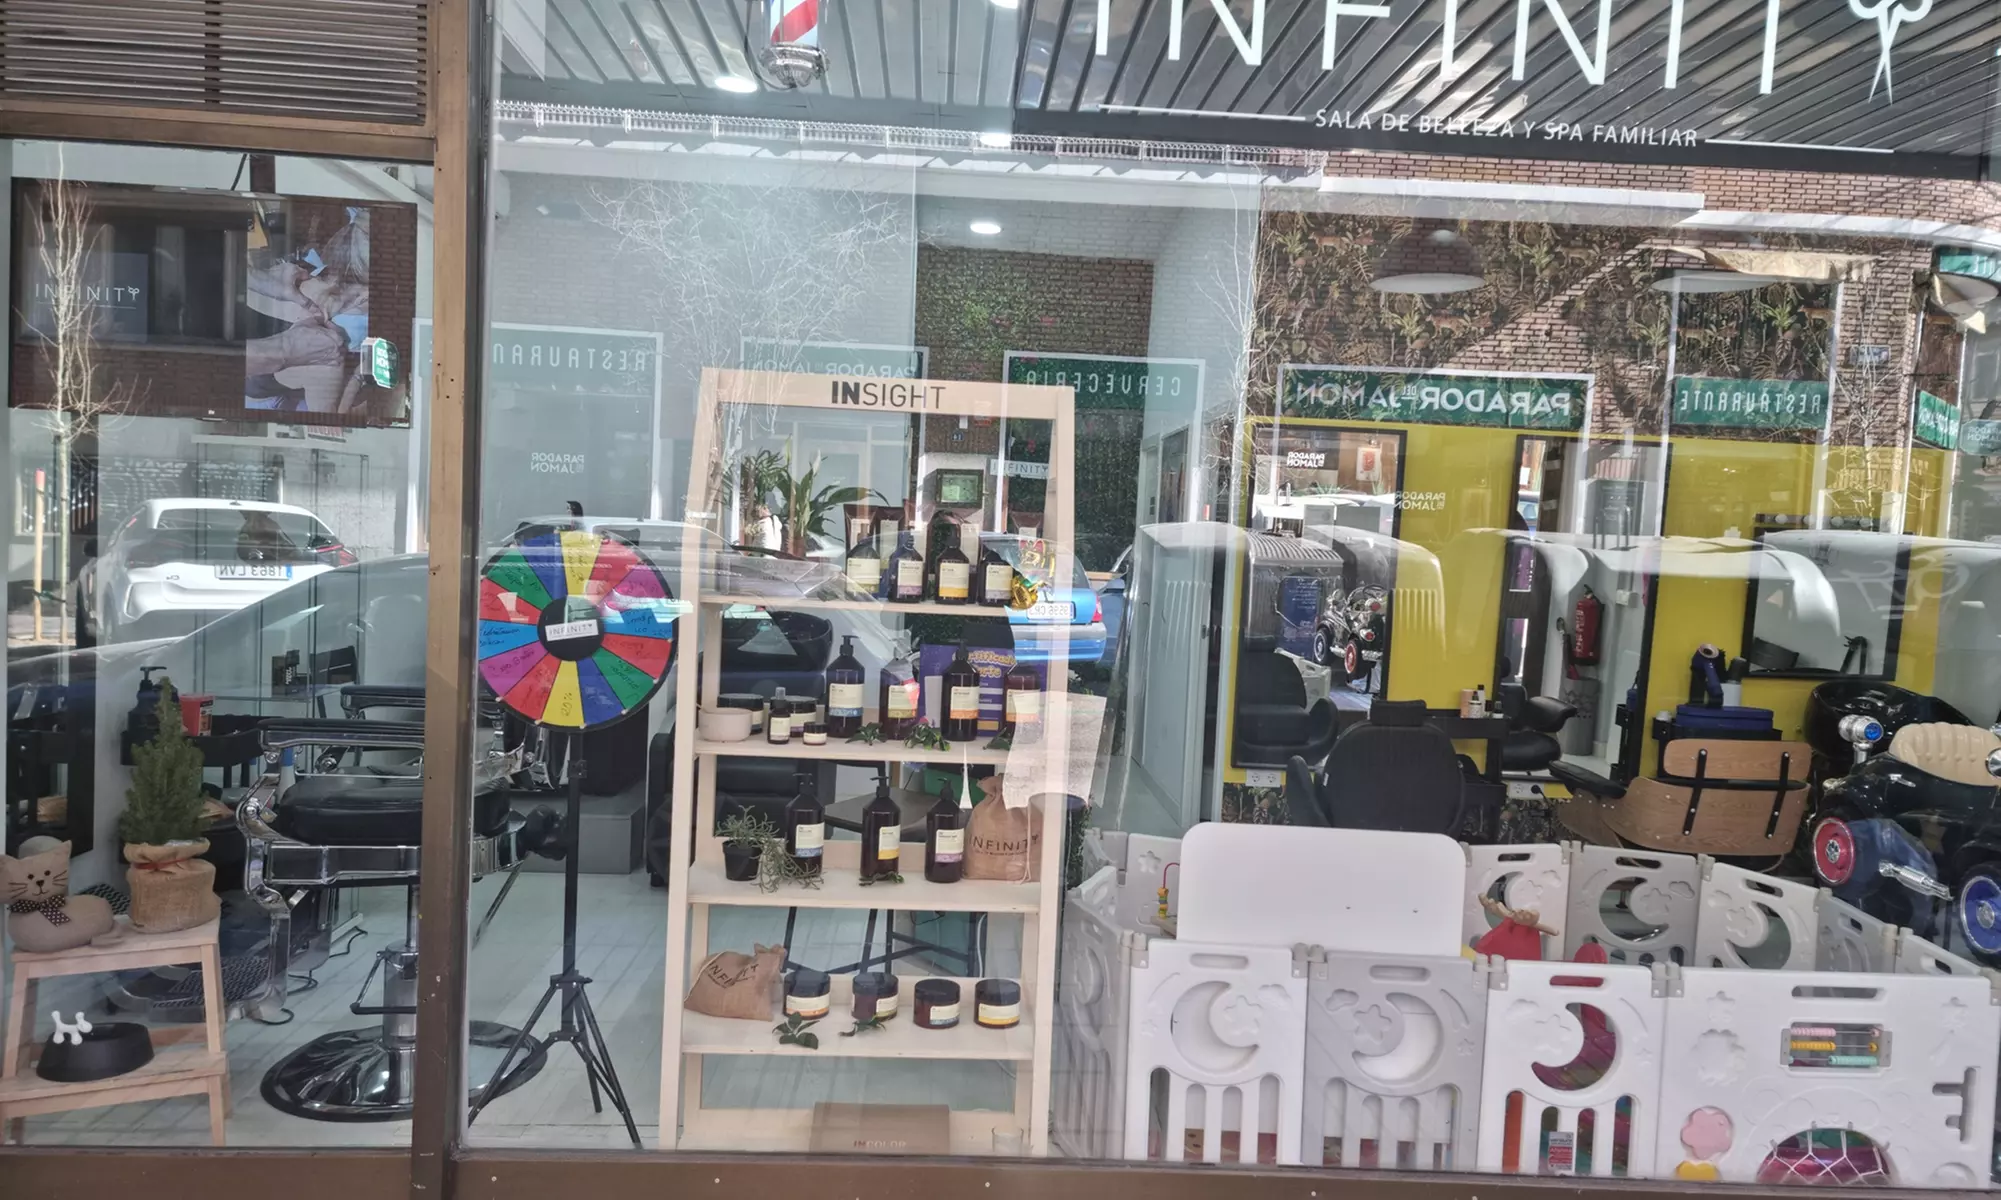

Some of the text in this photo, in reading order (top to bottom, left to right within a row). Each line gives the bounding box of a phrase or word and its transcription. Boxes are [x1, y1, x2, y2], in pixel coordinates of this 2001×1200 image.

[1316, 109, 1698, 147] SALA DE BELLEZA Y SPA FAMILIAR
[831, 380, 947, 409] INSIGHT
